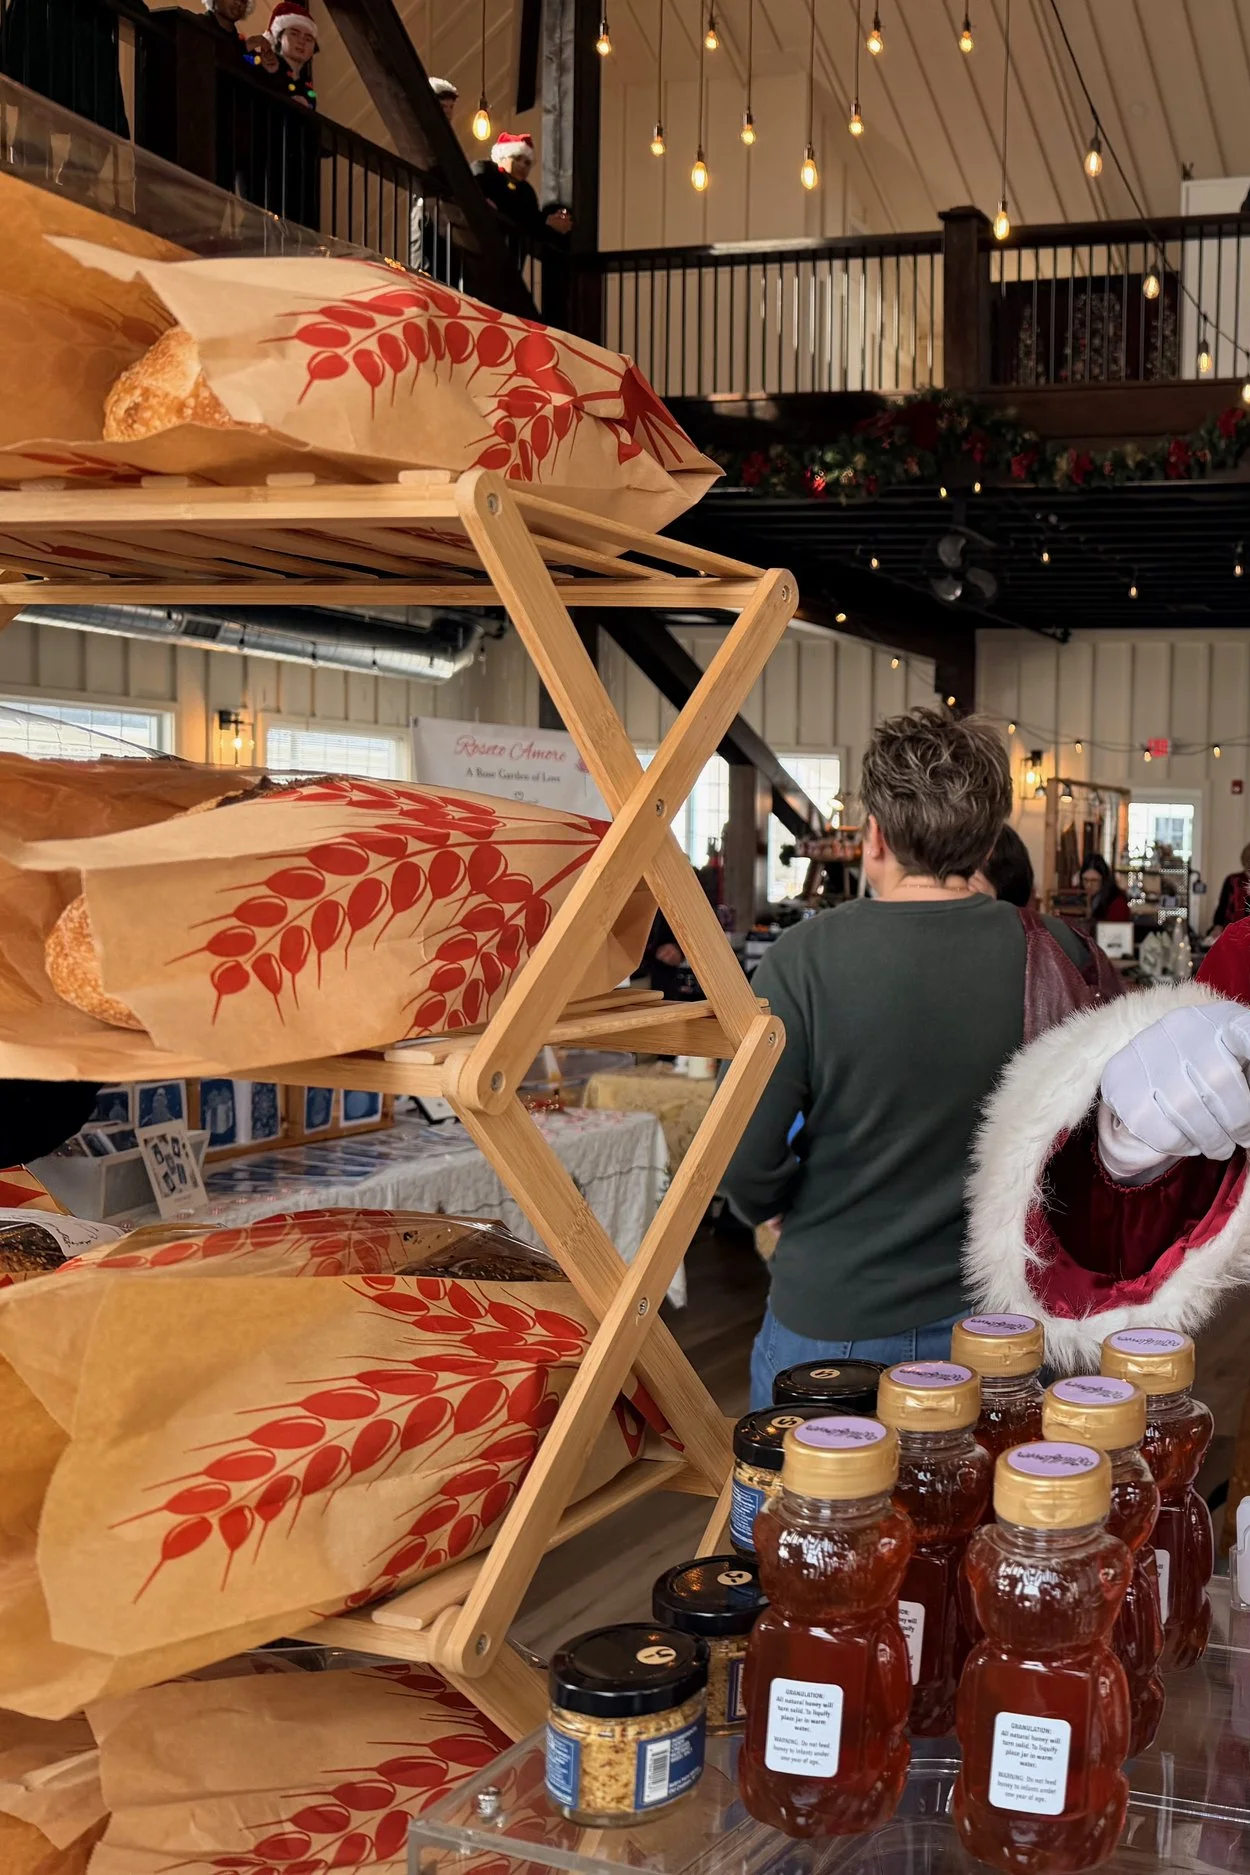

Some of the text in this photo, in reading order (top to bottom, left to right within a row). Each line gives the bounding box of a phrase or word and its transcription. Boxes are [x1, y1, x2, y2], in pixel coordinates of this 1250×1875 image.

[466, 769, 473, 777] A
[499, 769, 528, 781] Garden
[531, 772, 540, 781] of
